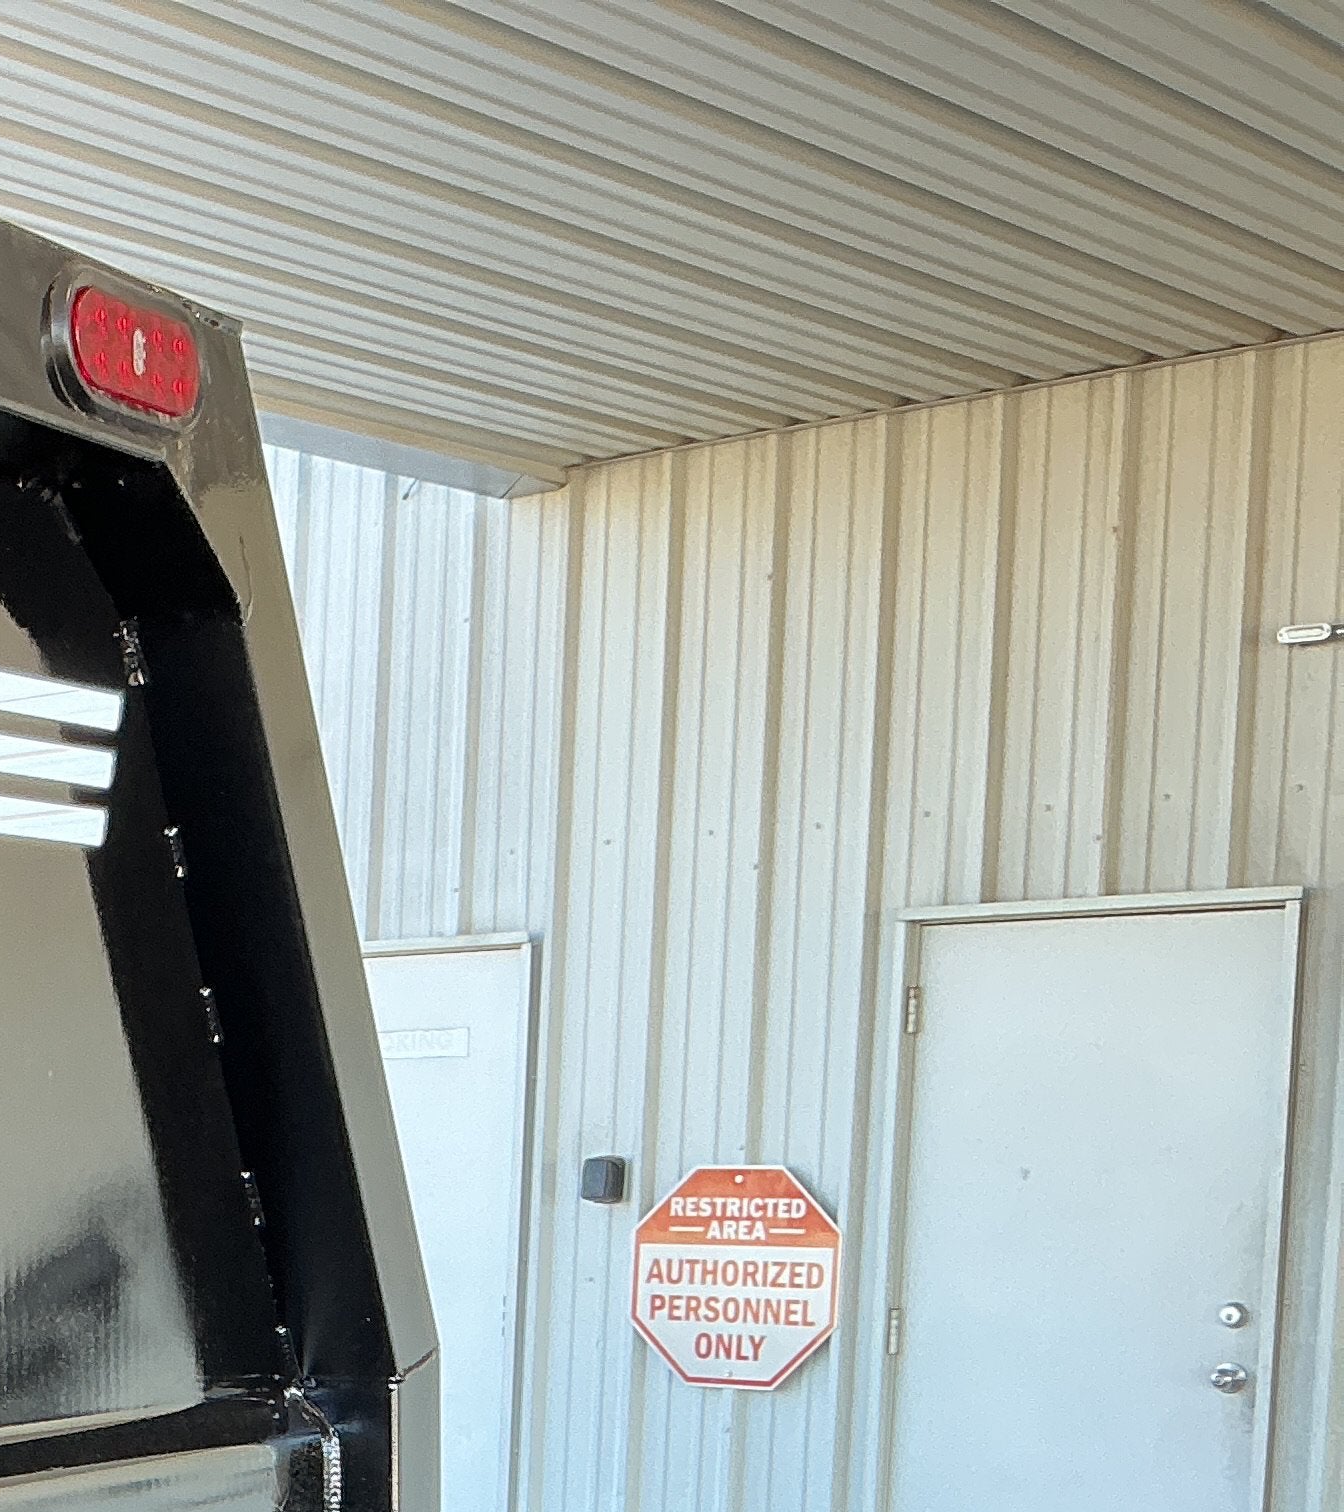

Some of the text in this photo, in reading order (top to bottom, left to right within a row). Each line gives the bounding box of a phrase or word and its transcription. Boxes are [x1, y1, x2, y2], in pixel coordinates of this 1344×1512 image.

[669, 1196, 807, 1219] RESTRICTED
[705, 1220, 767, 1241] AREA
[645, 1258, 824, 1290] AUTHORIZED
[648, 1294, 816, 1327] PERSONNEL
[694, 1332, 767, 1362] ONLY
